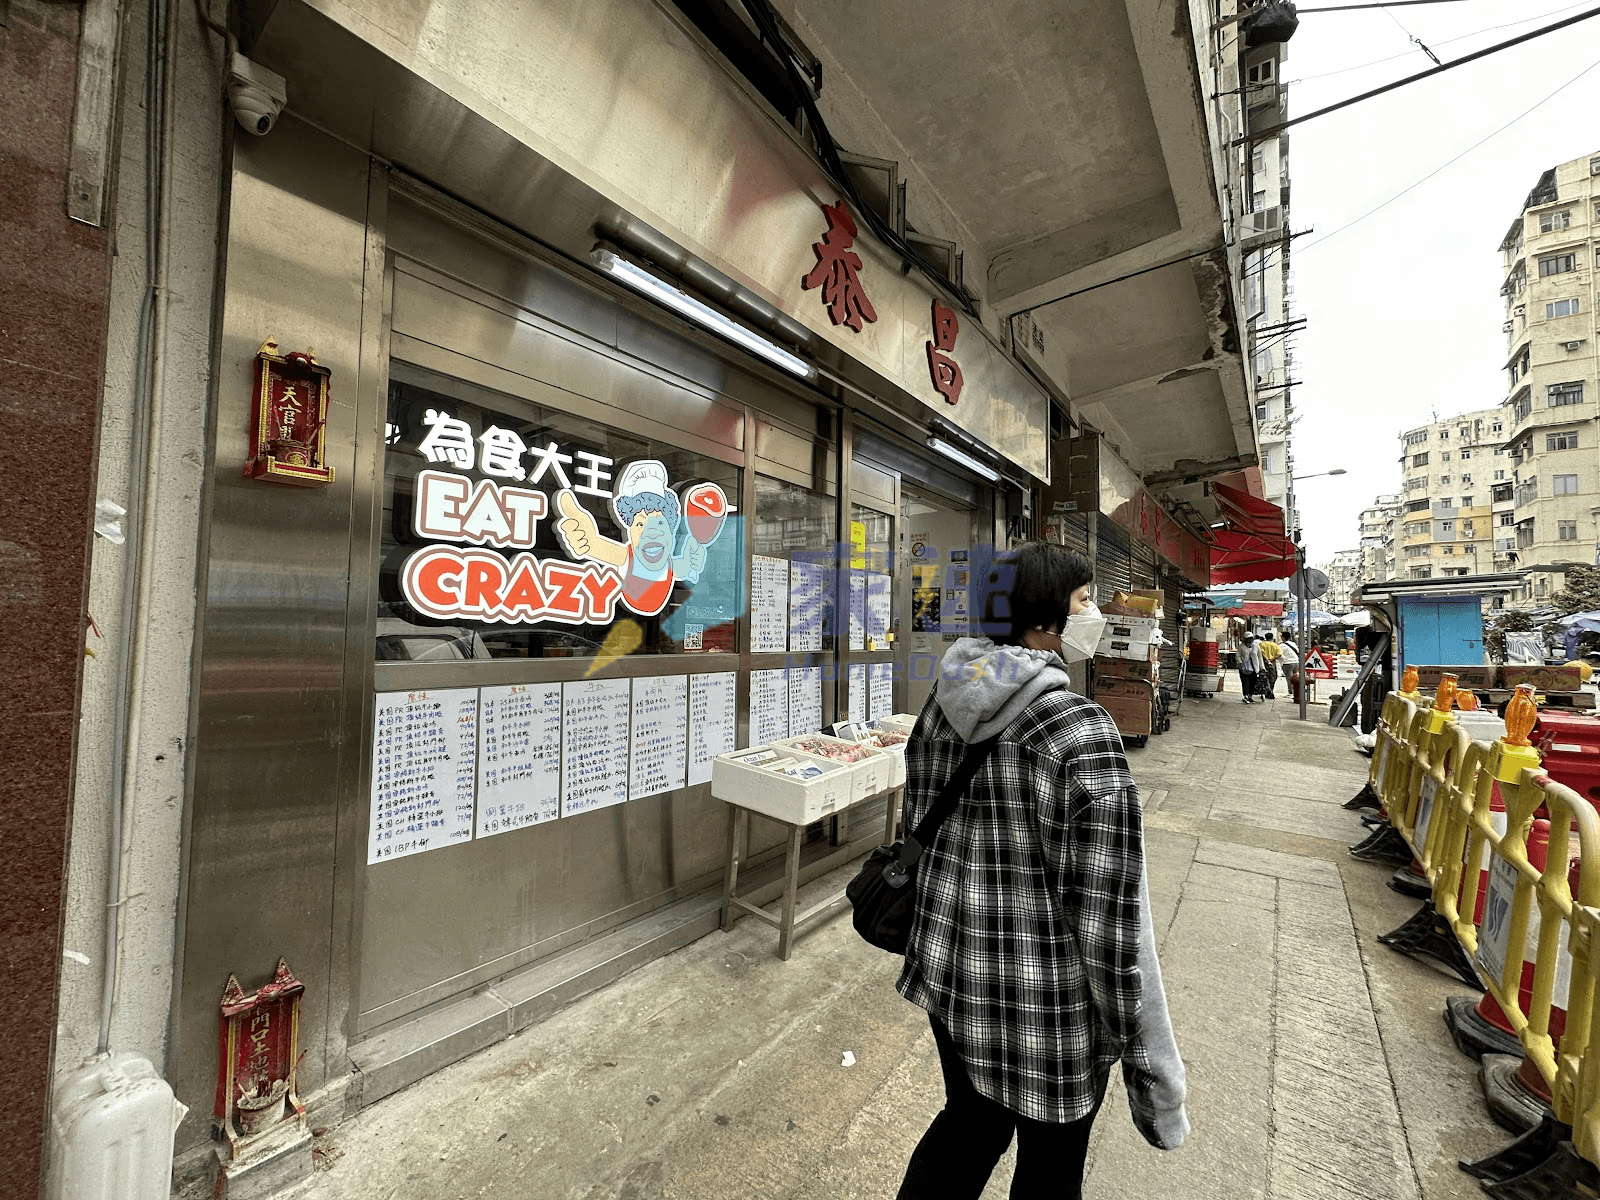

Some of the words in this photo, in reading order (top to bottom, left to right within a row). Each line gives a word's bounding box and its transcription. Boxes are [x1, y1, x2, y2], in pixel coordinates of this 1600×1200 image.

[801, 200, 964, 405] 泰昌
[418, 408, 614, 499] 為食大王
[418, 472, 546, 546] EAT
[409, 551, 621, 623] CRAZY
